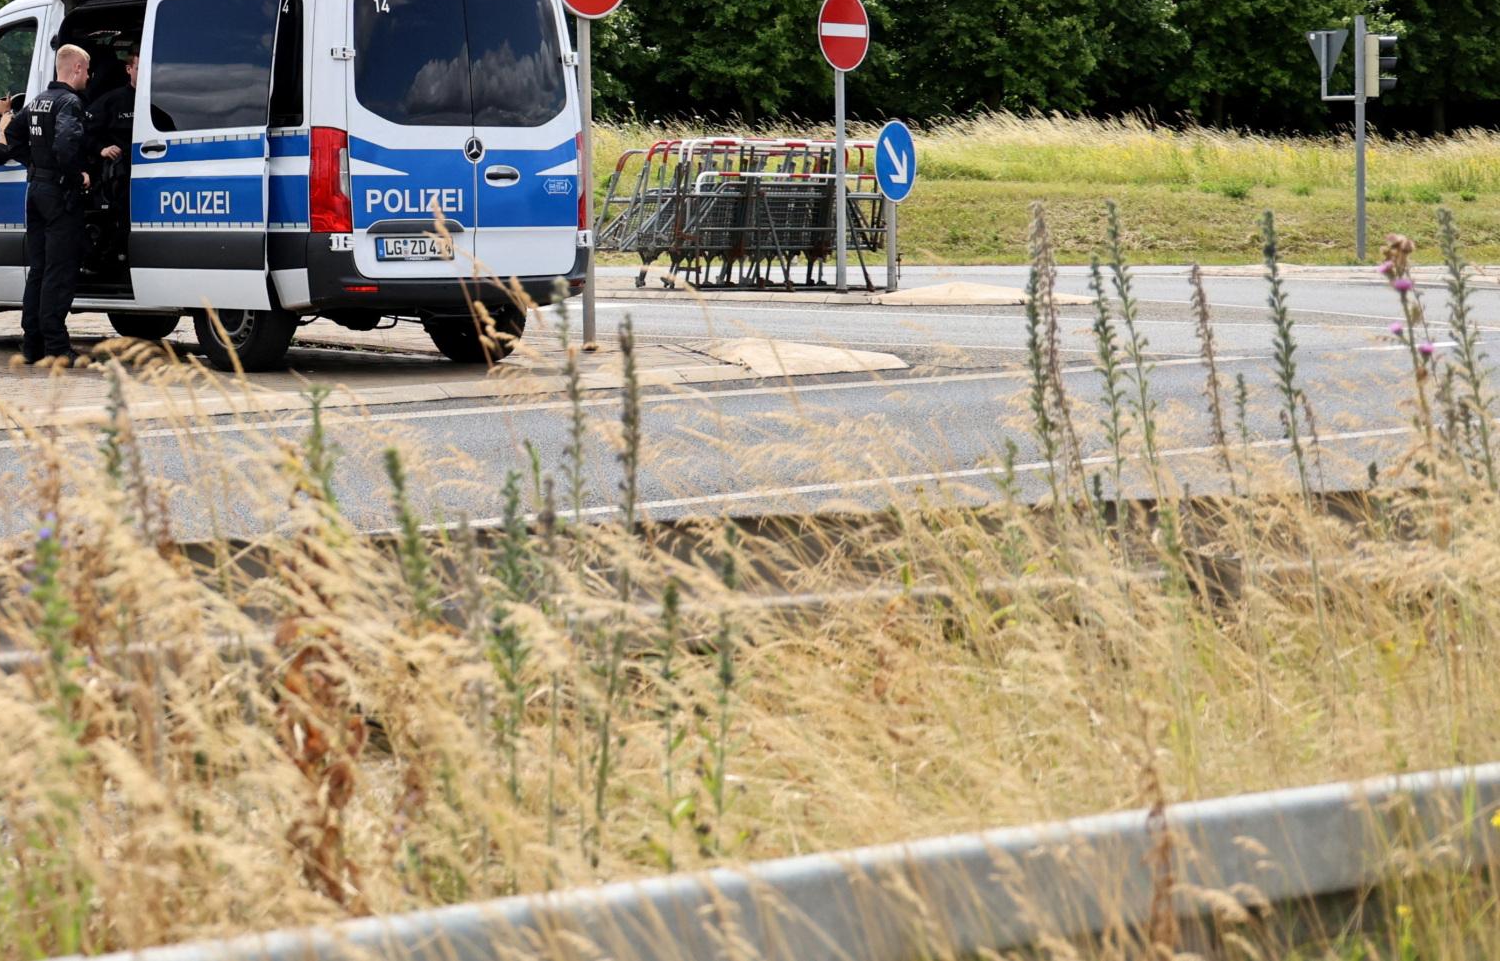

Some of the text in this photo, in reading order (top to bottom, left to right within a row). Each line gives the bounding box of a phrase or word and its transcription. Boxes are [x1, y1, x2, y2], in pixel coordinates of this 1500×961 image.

[281, 0, 290, 13] 4
[28, 100, 54, 112] OLIZEI
[160, 191, 230, 214] POLIZEI
[366, 189, 463, 213] POLIZEI
[385, 240, 451, 255] LG ZD 44
